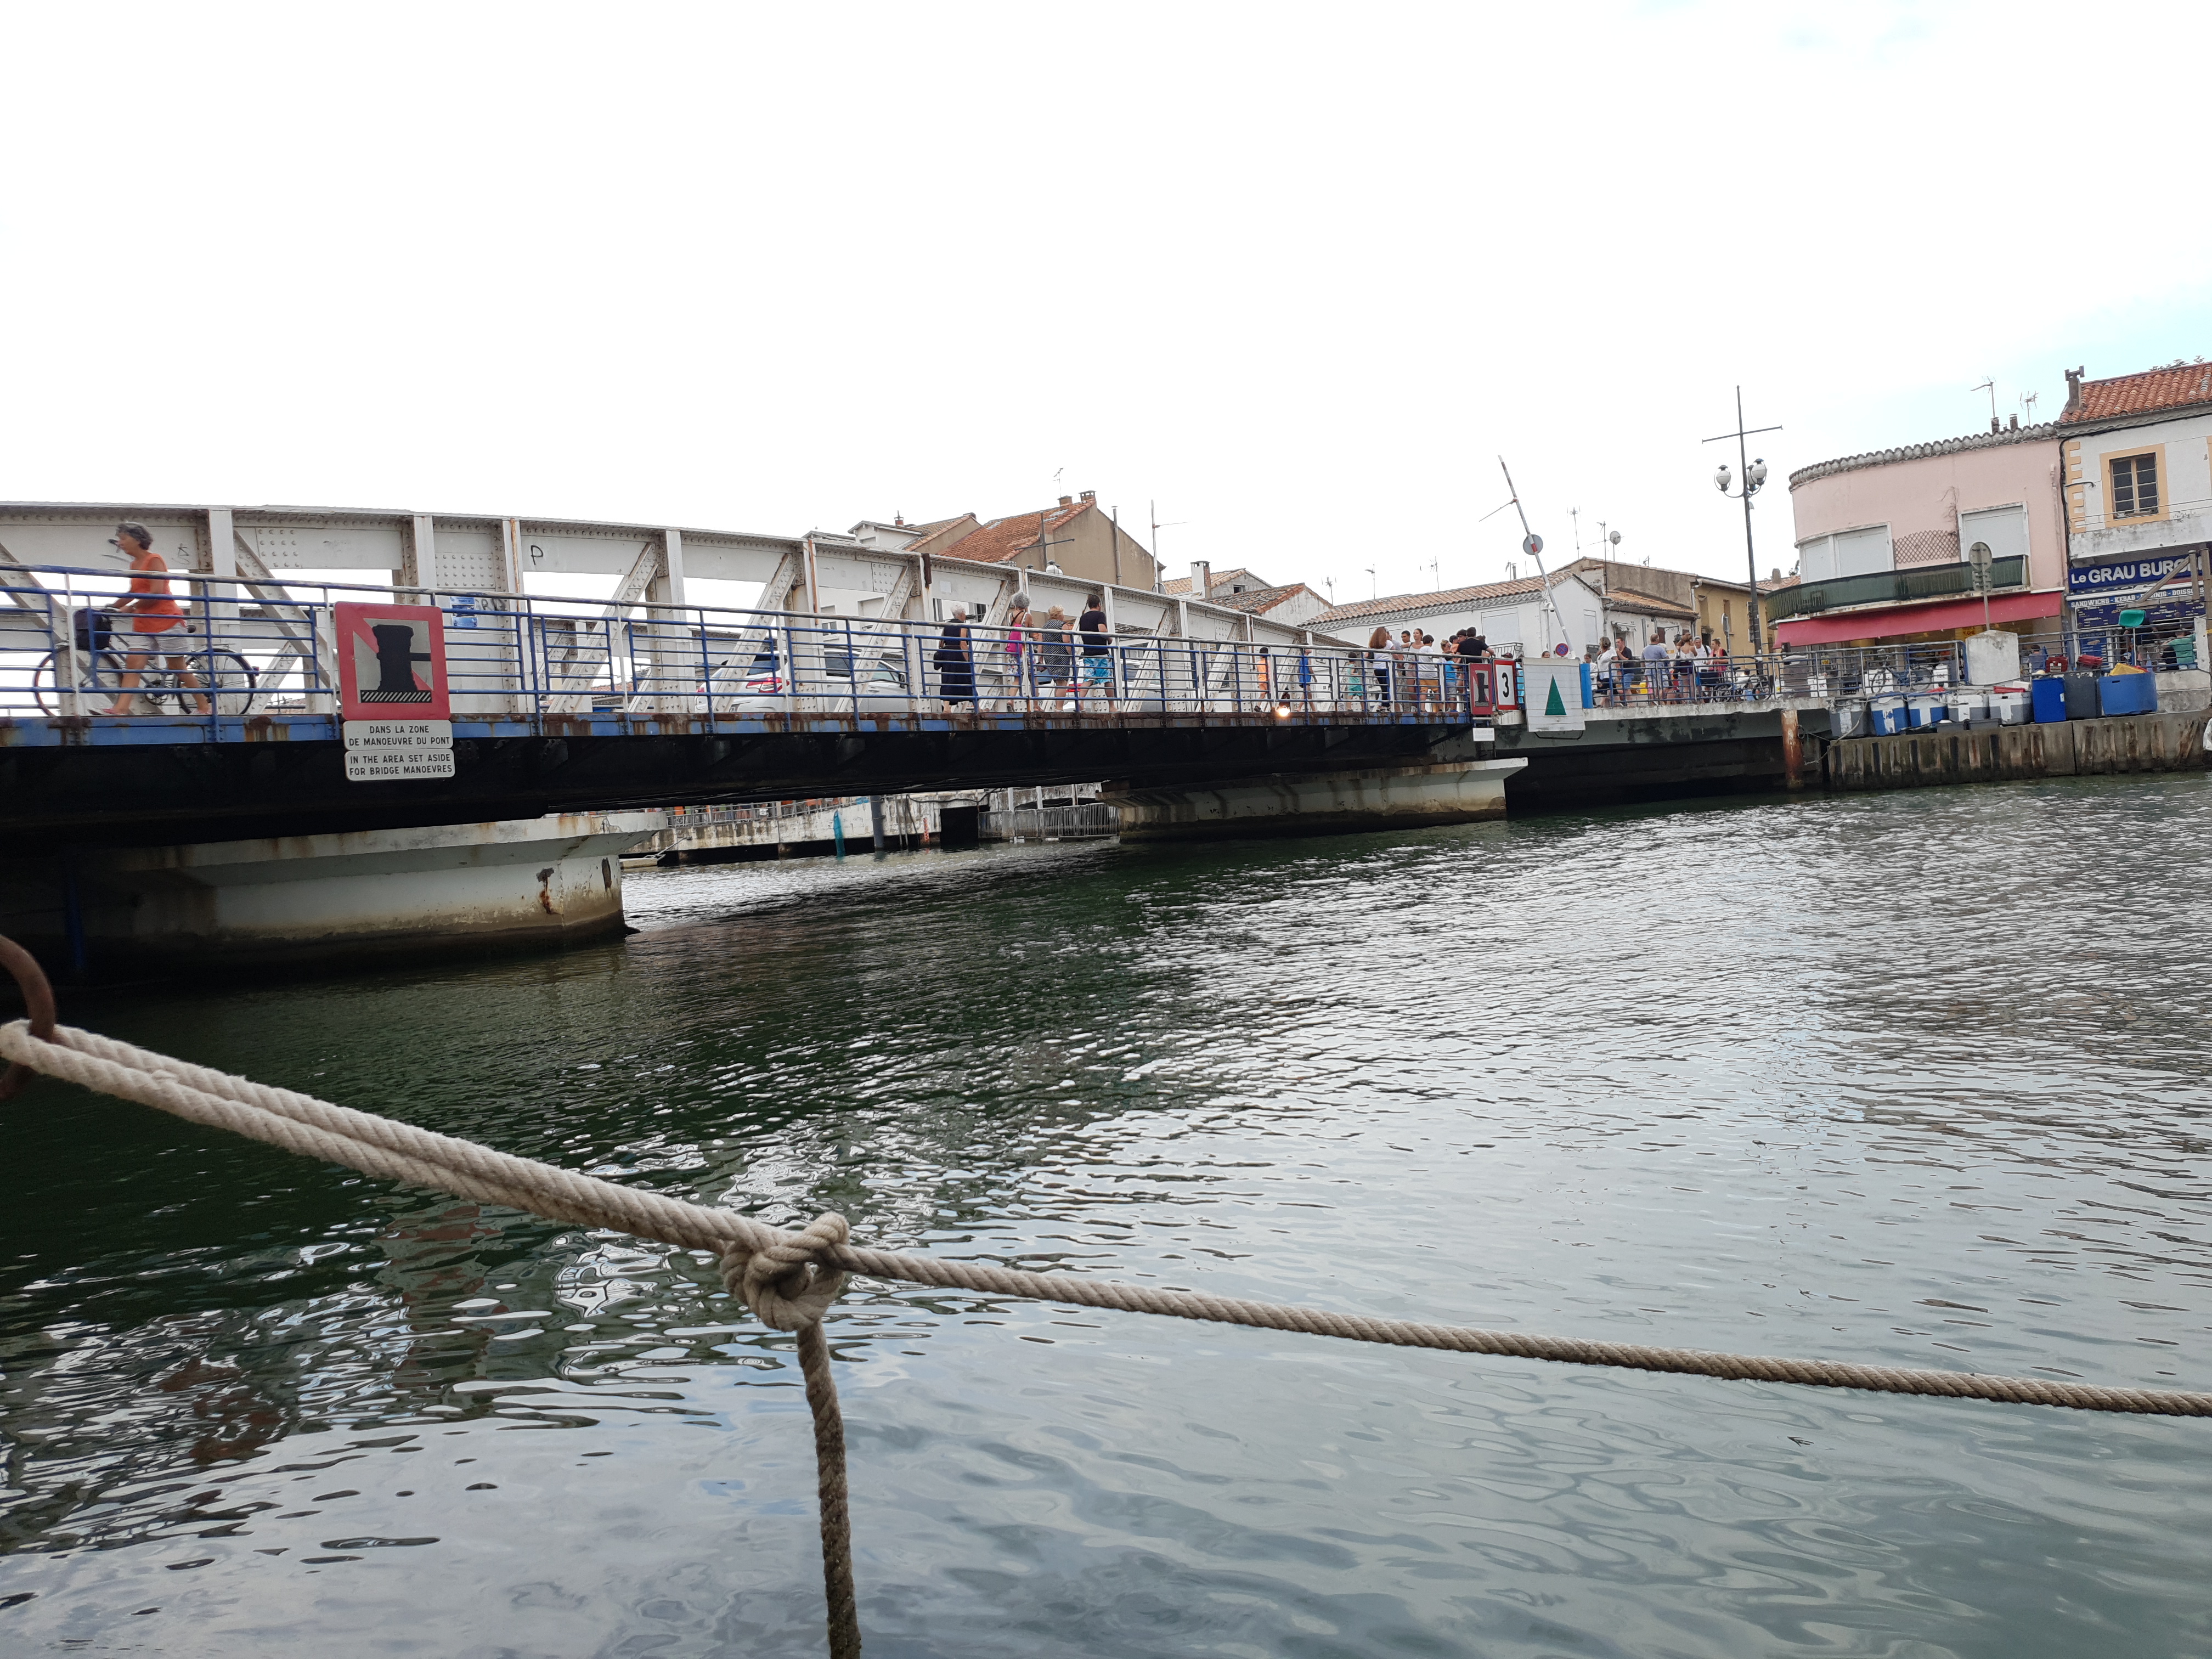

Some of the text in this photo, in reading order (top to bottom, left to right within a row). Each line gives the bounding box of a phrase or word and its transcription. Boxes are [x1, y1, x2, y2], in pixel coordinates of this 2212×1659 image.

[531, 545, 543, 565] P
[2071, 573, 2086, 584] Le
[2088, 565, 2136, 583] GRAU
[2071, 597, 2109, 607] SANDWICHS
[1502, 672, 1509, 698] 3
[395, 725, 405, 733] LA
[349, 736, 450, 746] DE MANOEUVRE DU PONT
[350, 755, 359, 764] IN
[363, 755, 379, 764] THE
[383, 755, 404, 763] AREA
[349, 765, 453, 776] FOR BRIDGE MANOEVRES
